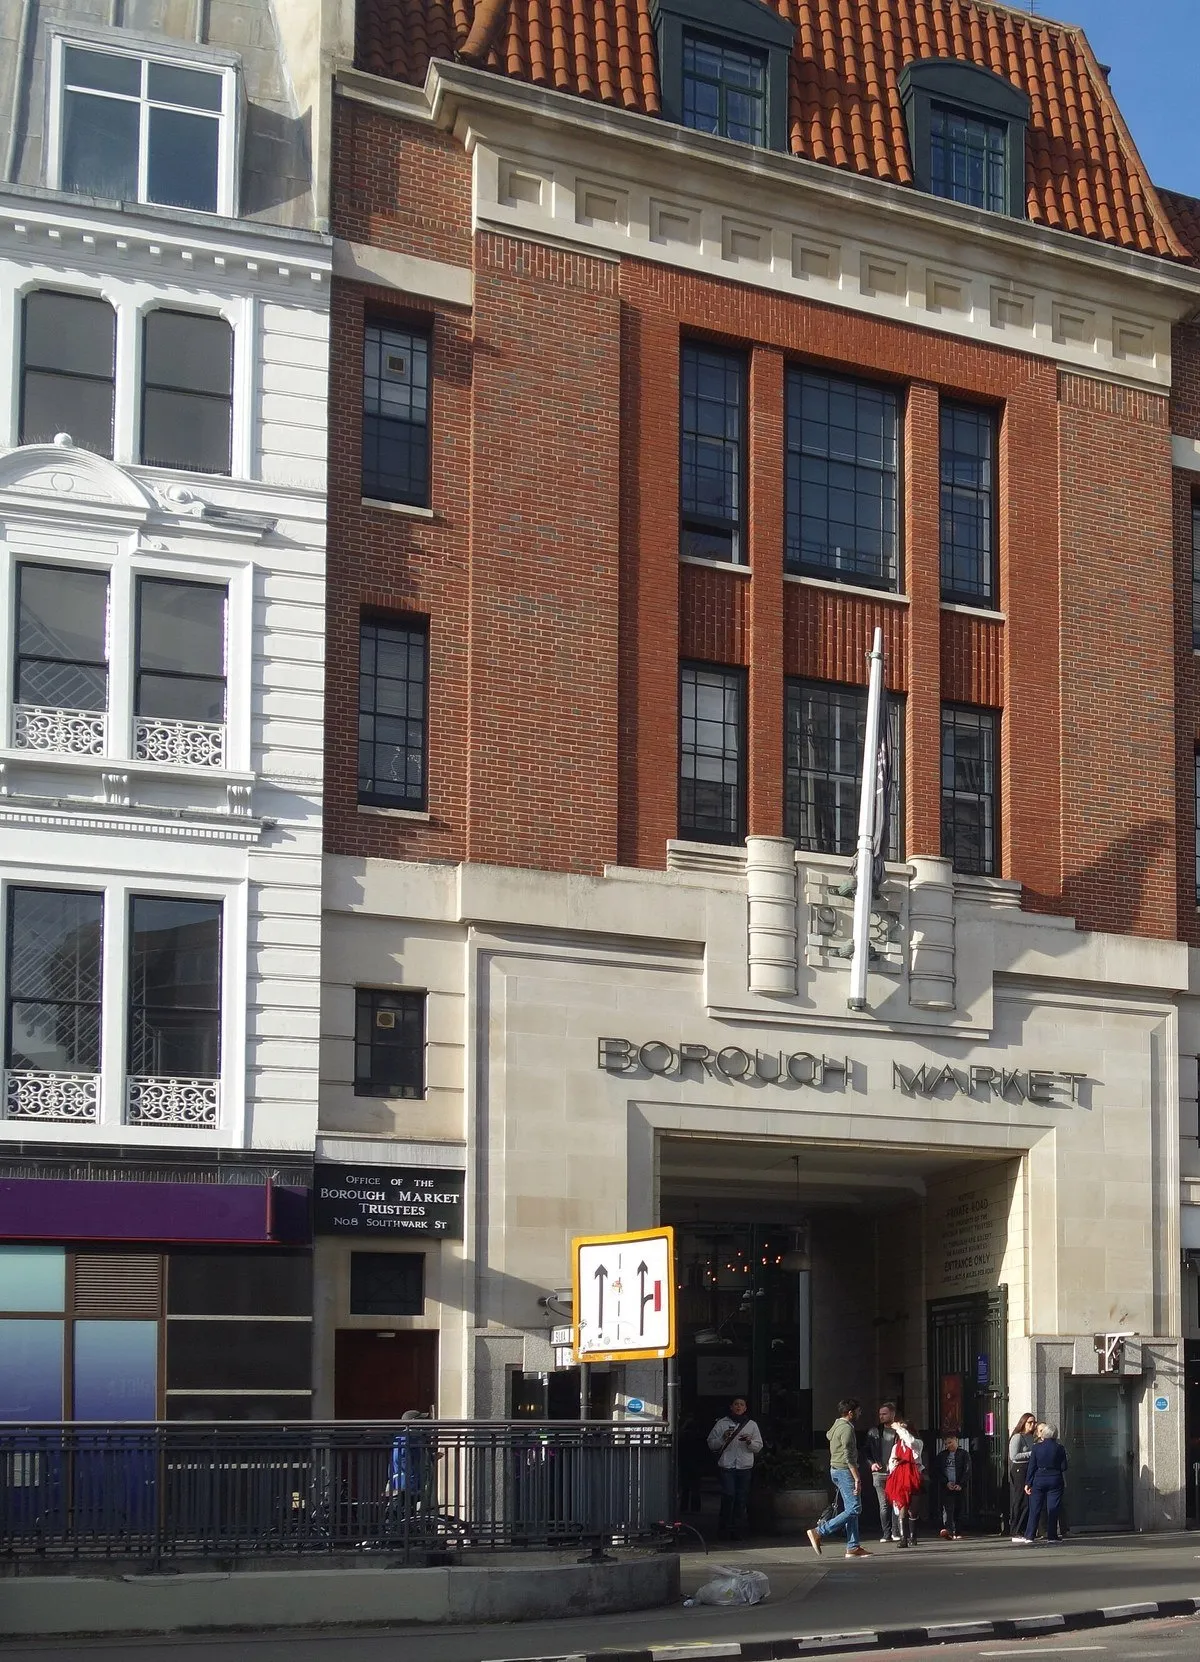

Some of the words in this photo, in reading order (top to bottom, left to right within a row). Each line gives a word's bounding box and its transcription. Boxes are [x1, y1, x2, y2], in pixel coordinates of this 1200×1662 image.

[597, 1036, 850, 1088] BOROUGH
[891, 1058, 1089, 1102] MARKET
[414, 1179, 434, 1188] THE
[320, 1188, 386, 1201] BOROUGH
[399, 1191, 460, 1204] MARKET
[359, 1202, 426, 1216] TRUSTEES
[366, 1217, 428, 1229] SOUTHWARK
